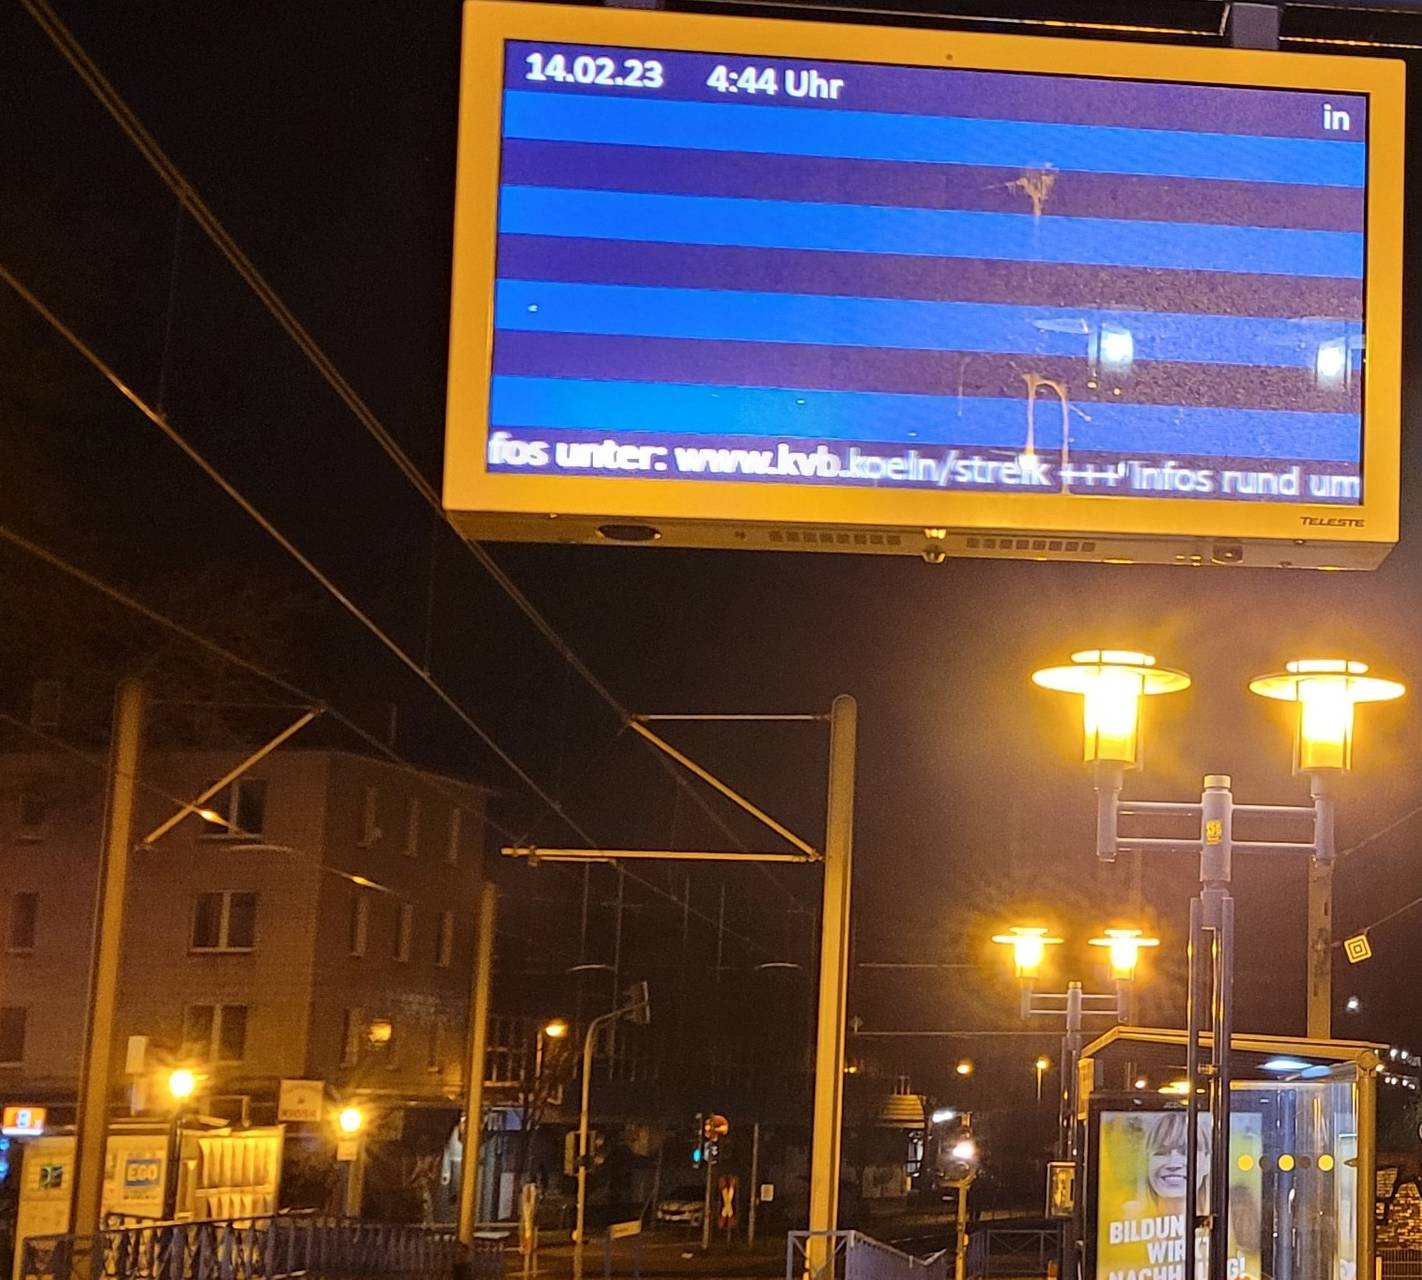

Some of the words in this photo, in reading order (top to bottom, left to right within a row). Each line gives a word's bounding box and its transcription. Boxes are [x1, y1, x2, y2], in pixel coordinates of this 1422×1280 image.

[525, 52, 664, 89] 14.02.23
[706, 64, 778, 96] 4:44
[784, 68, 844, 100] Uhr
[1323, 103, 1350, 131] in
[555, 438, 668, 472] unter:
[1130, 459, 1214, 493] Infos
[1220, 465, 1300, 496] rund
[1308, 474, 1360, 499] um
[1299, 515, 1365, 528] TELESTE
[1109, 1215, 1196, 1245] BILDUN
